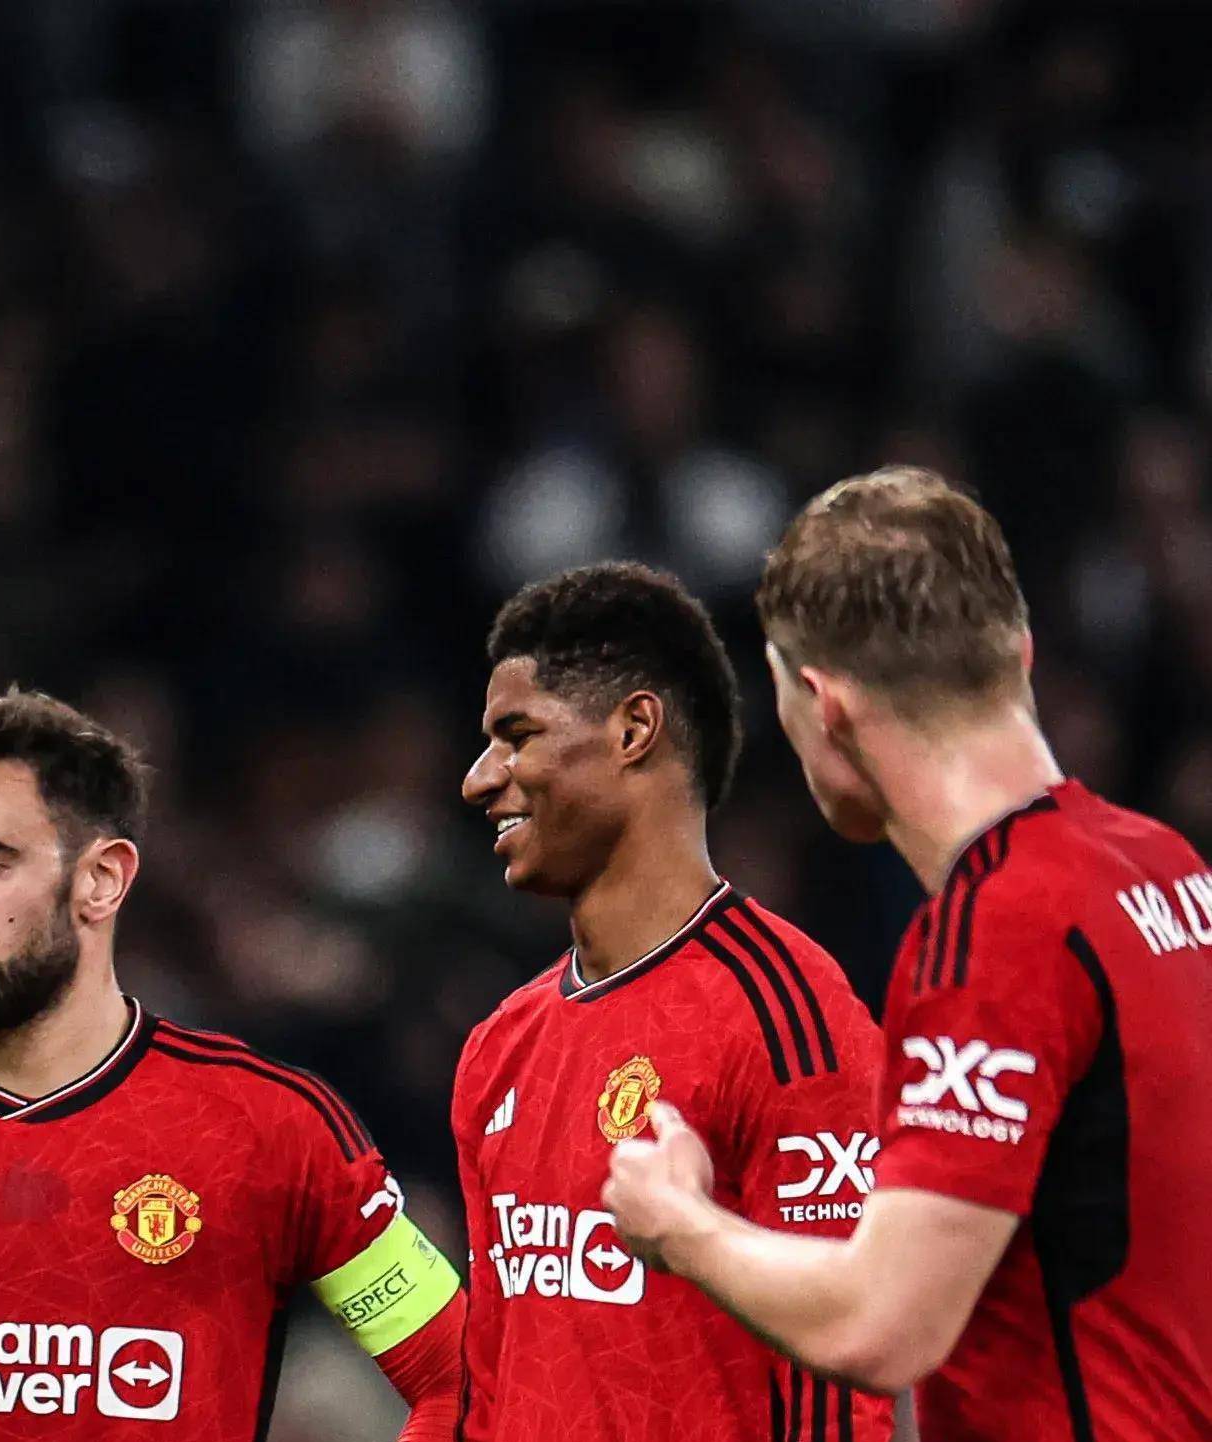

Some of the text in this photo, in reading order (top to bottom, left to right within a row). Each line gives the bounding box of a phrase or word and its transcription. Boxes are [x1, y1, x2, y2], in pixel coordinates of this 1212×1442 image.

[779, 1202, 865, 1223] TECHNO
[131, 1241, 183, 1258] UNITED
[339, 1267, 410, 1323] ESPECT
